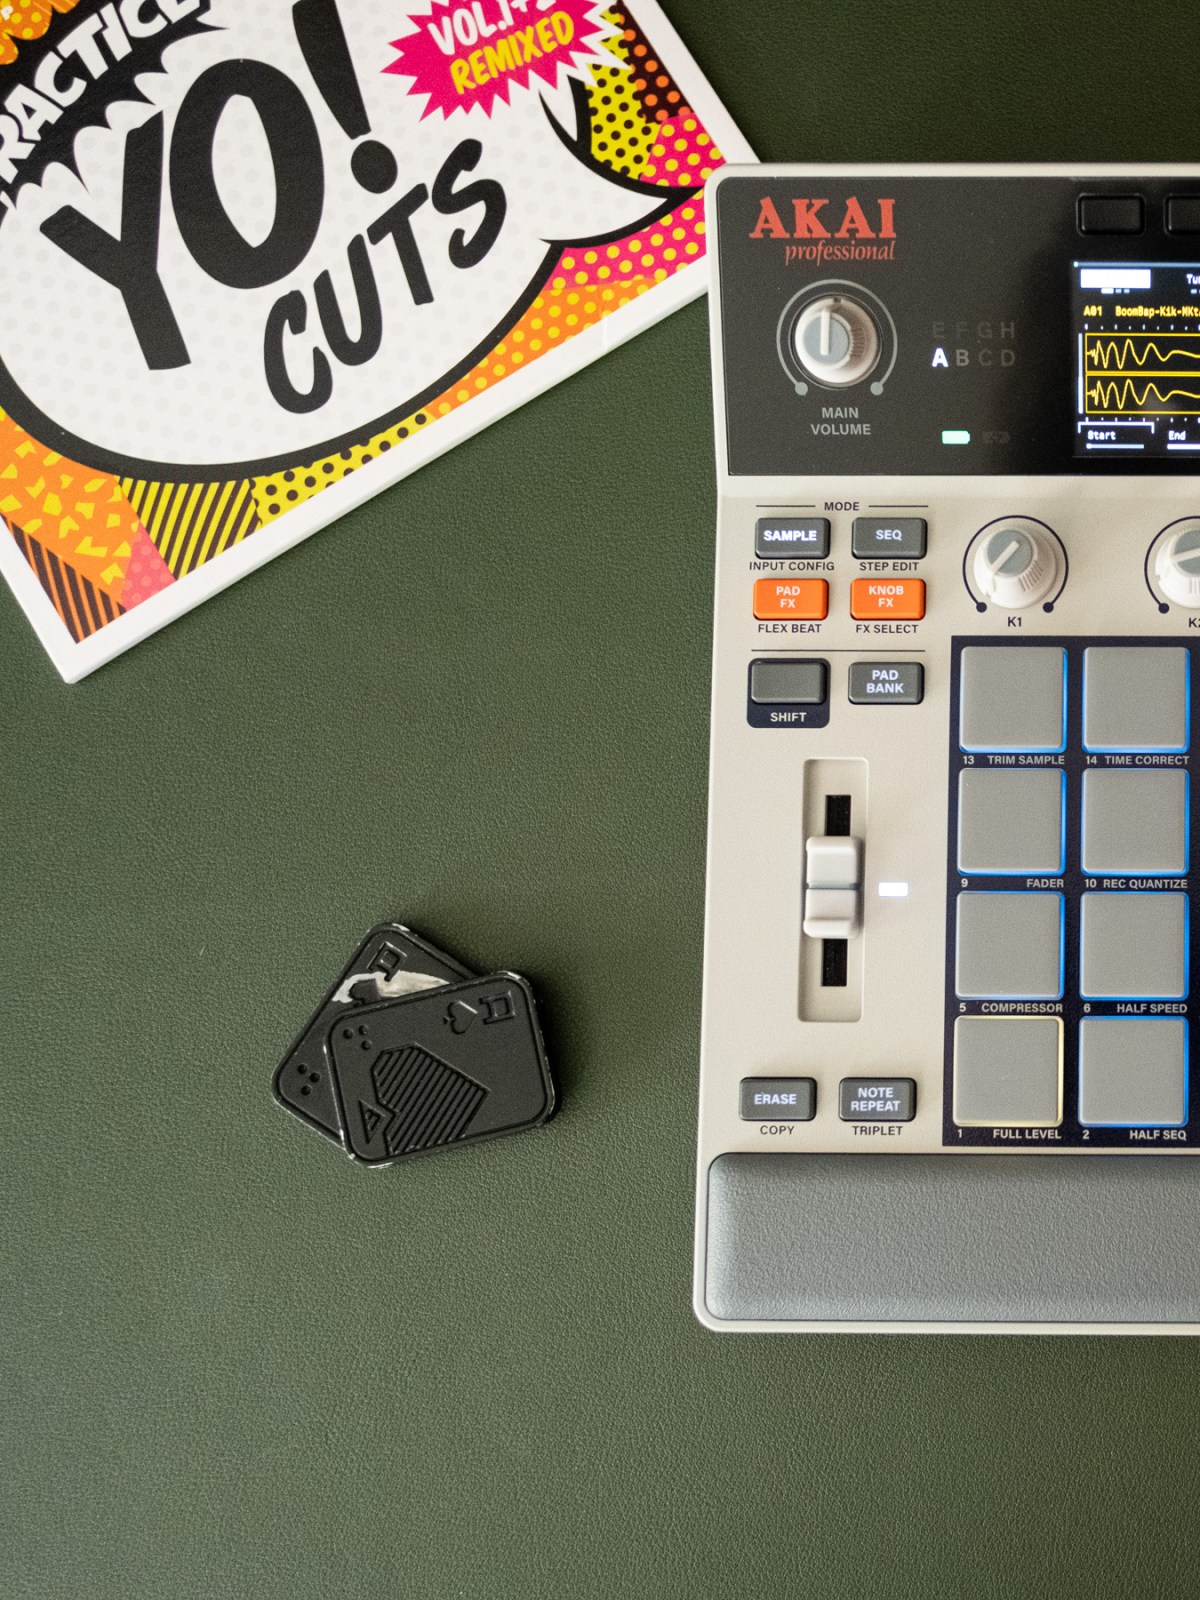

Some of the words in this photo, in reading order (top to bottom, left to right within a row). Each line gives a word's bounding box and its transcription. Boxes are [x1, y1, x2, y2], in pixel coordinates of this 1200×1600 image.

[450, 11, 574, 94] REMIXED
[40, 0, 398, 370] YO!
[749, 196, 897, 239] AKAI
[785, 240, 896, 267] professional
[264, 139, 506, 413] CUTS
[931, 346, 950, 368] A
[955, 348, 970, 367] B
[822, 406, 858, 419] MAIN
[810, 423, 872, 436] VOLUME
[1088, 430, 1116, 440] Start
[1168, 430, 1186, 440] End
[824, 502, 860, 511] MODE
[763, 530, 818, 542] SAMPLE
[875, 530, 902, 542] SEQ
[749, 562, 785, 571] INPUT
[788, 562, 835, 571] CONFIG
[859, 562, 889, 571] STEP
[892, 562, 919, 571] EDIT
[776, 586, 800, 596] PAD
[868, 585, 904, 595] KNOB
[780, 598, 796, 608] FX
[878, 598, 894, 608] FX
[1007, 616, 1022, 627] K1
[758, 624, 788, 633] FLEX
[791, 624, 822, 633] BEAT
[856, 624, 871, 634] FX
[873, 624, 919, 634] SELECT
[872, 670, 899, 680] PAD
[866, 683, 904, 694] BANK
[770, 712, 807, 722] SHIFT
[963, 755, 974, 765] 13
[988, 755, 1016, 765] TRIM
[1018, 755, 1065, 765] SAMPLE
[1086, 755, 1098, 765] 14
[1104, 755, 1132, 765] TIME
[1135, 755, 1190, 765] CORRECT
[961, 878, 968, 888] 9
[1026, 878, 1064, 888] FADER
[1084, 879, 1097, 889] 10
[1102, 879, 1126, 889] REC
[1129, 879, 1188, 889] QUANTIZE
[959, 1003, 966, 1013] 5
[981, 1003, 1063, 1013] COMPRESSOR
[1083, 1004, 1091, 1014] 6
[1116, 1004, 1147, 1014] HALF
[1149, 1004, 1188, 1014] SPEED
[857, 1087, 894, 1098] NOTE
[754, 1094, 797, 1105] ERASE
[850, 1101, 900, 1112] REPEAT
[760, 1125, 795, 1136] COPY
[852, 1126, 903, 1136] TRIPLET
[957, 1129, 962, 1139] 1
[993, 1129, 1022, 1139] FULL
[1025, 1129, 1062, 1139] LEVEL
[1082, 1130, 1090, 1140] 2
[1129, 1130, 1160, 1140] HALF
[1162, 1130, 1187, 1140] SEQ
